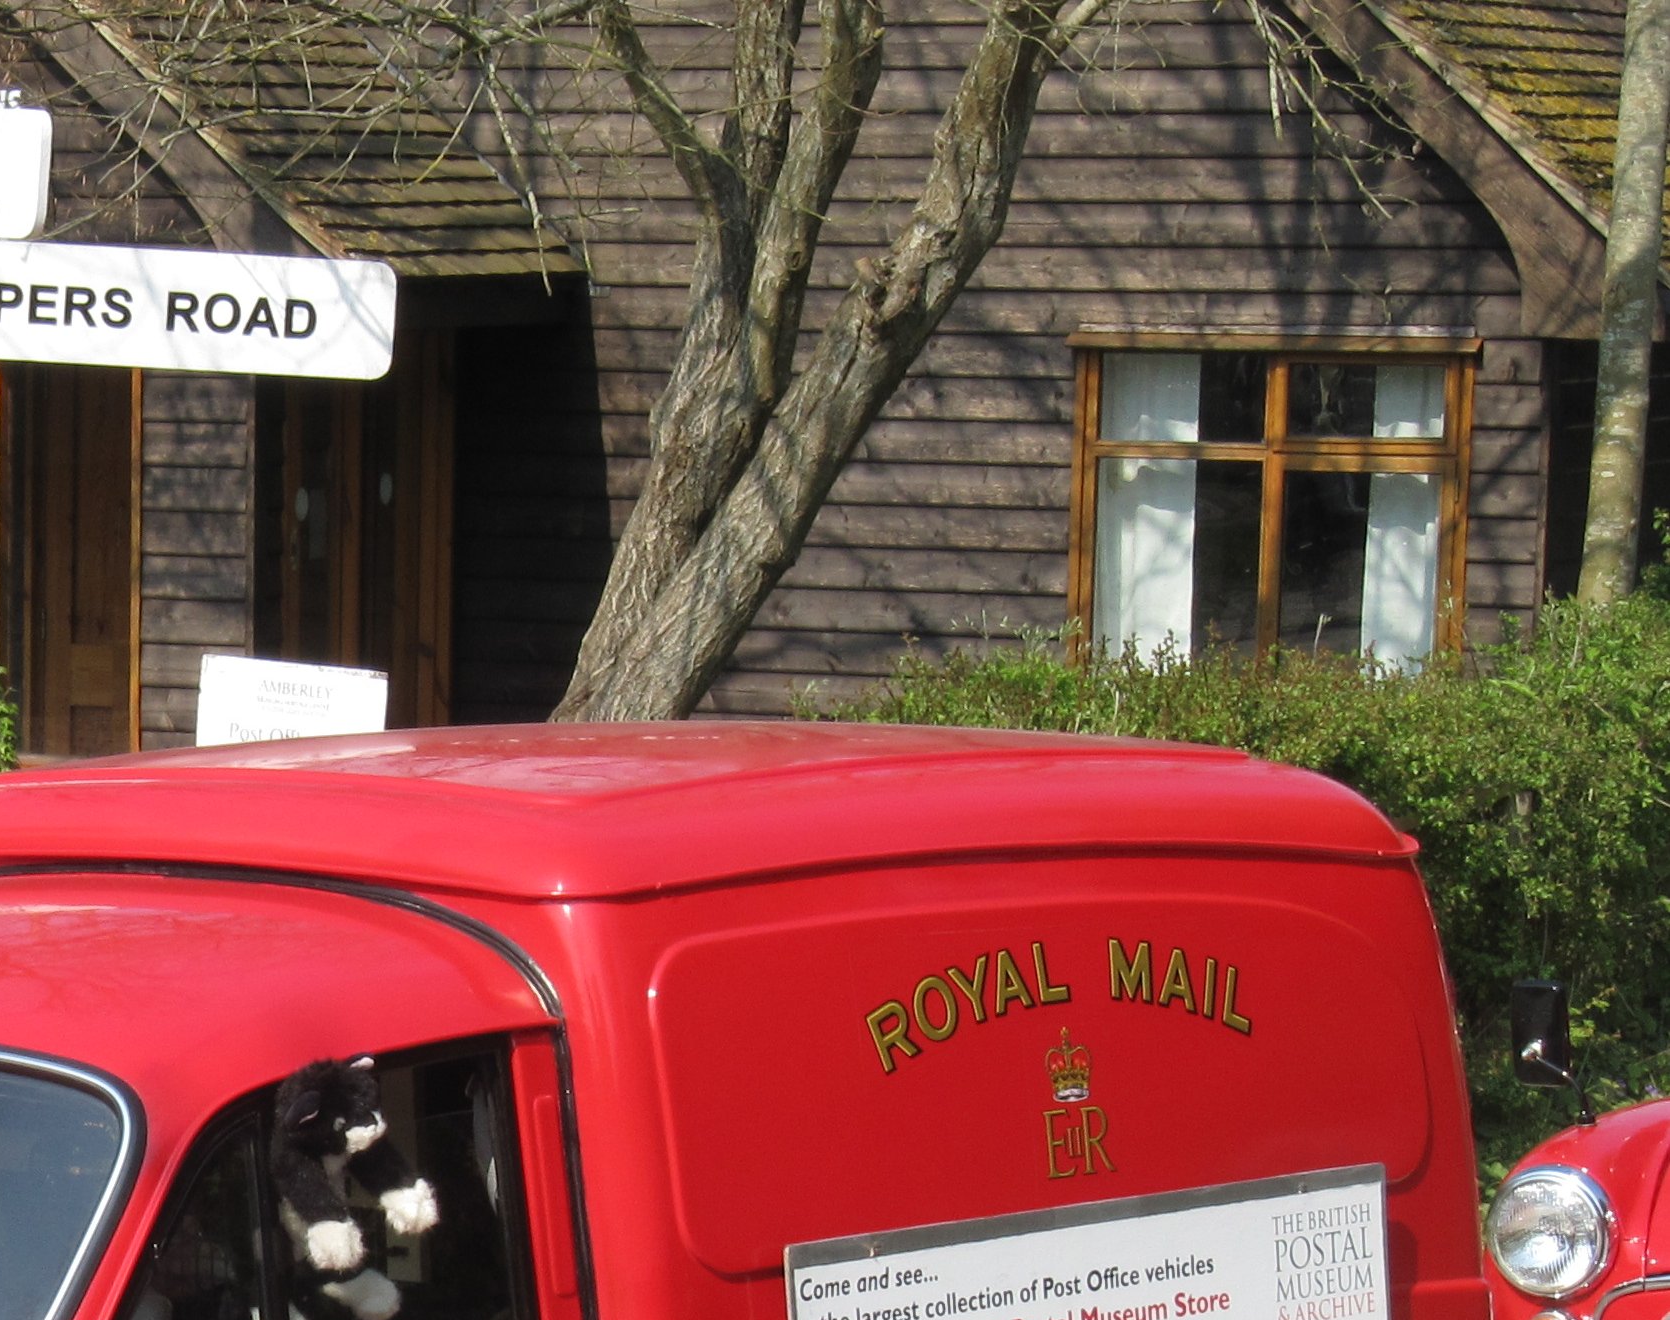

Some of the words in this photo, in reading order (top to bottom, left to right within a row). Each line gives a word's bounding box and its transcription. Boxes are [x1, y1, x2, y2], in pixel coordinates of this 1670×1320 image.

[165, 291, 318, 340] ROAD
[259, 679, 334, 700] AMBERLEY
[864, 940, 1072, 1075] ROYAL
[1107, 936, 1253, 1036] MAIL
[1271, 1212, 1304, 1236] THE
[1308, 1202, 1372, 1231] BRITISH
[1274, 1225, 1374, 1273] POSTAL
[799, 1278, 851, 1302] Come
[856, 1266, 890, 1293] and
[895, 1267, 939, 1288] see...
[925, 1286, 1014, 1318] collection
[1020, 1278, 1039, 1304] of
[1042, 1275, 1082, 1300] Post
[1086, 1265, 1141, 1292] Office
[1144, 1254, 1215, 1283] vehicles
[1276, 1262, 1375, 1303] MUSEUM
[1173, 1291, 1231, 1318] Store
